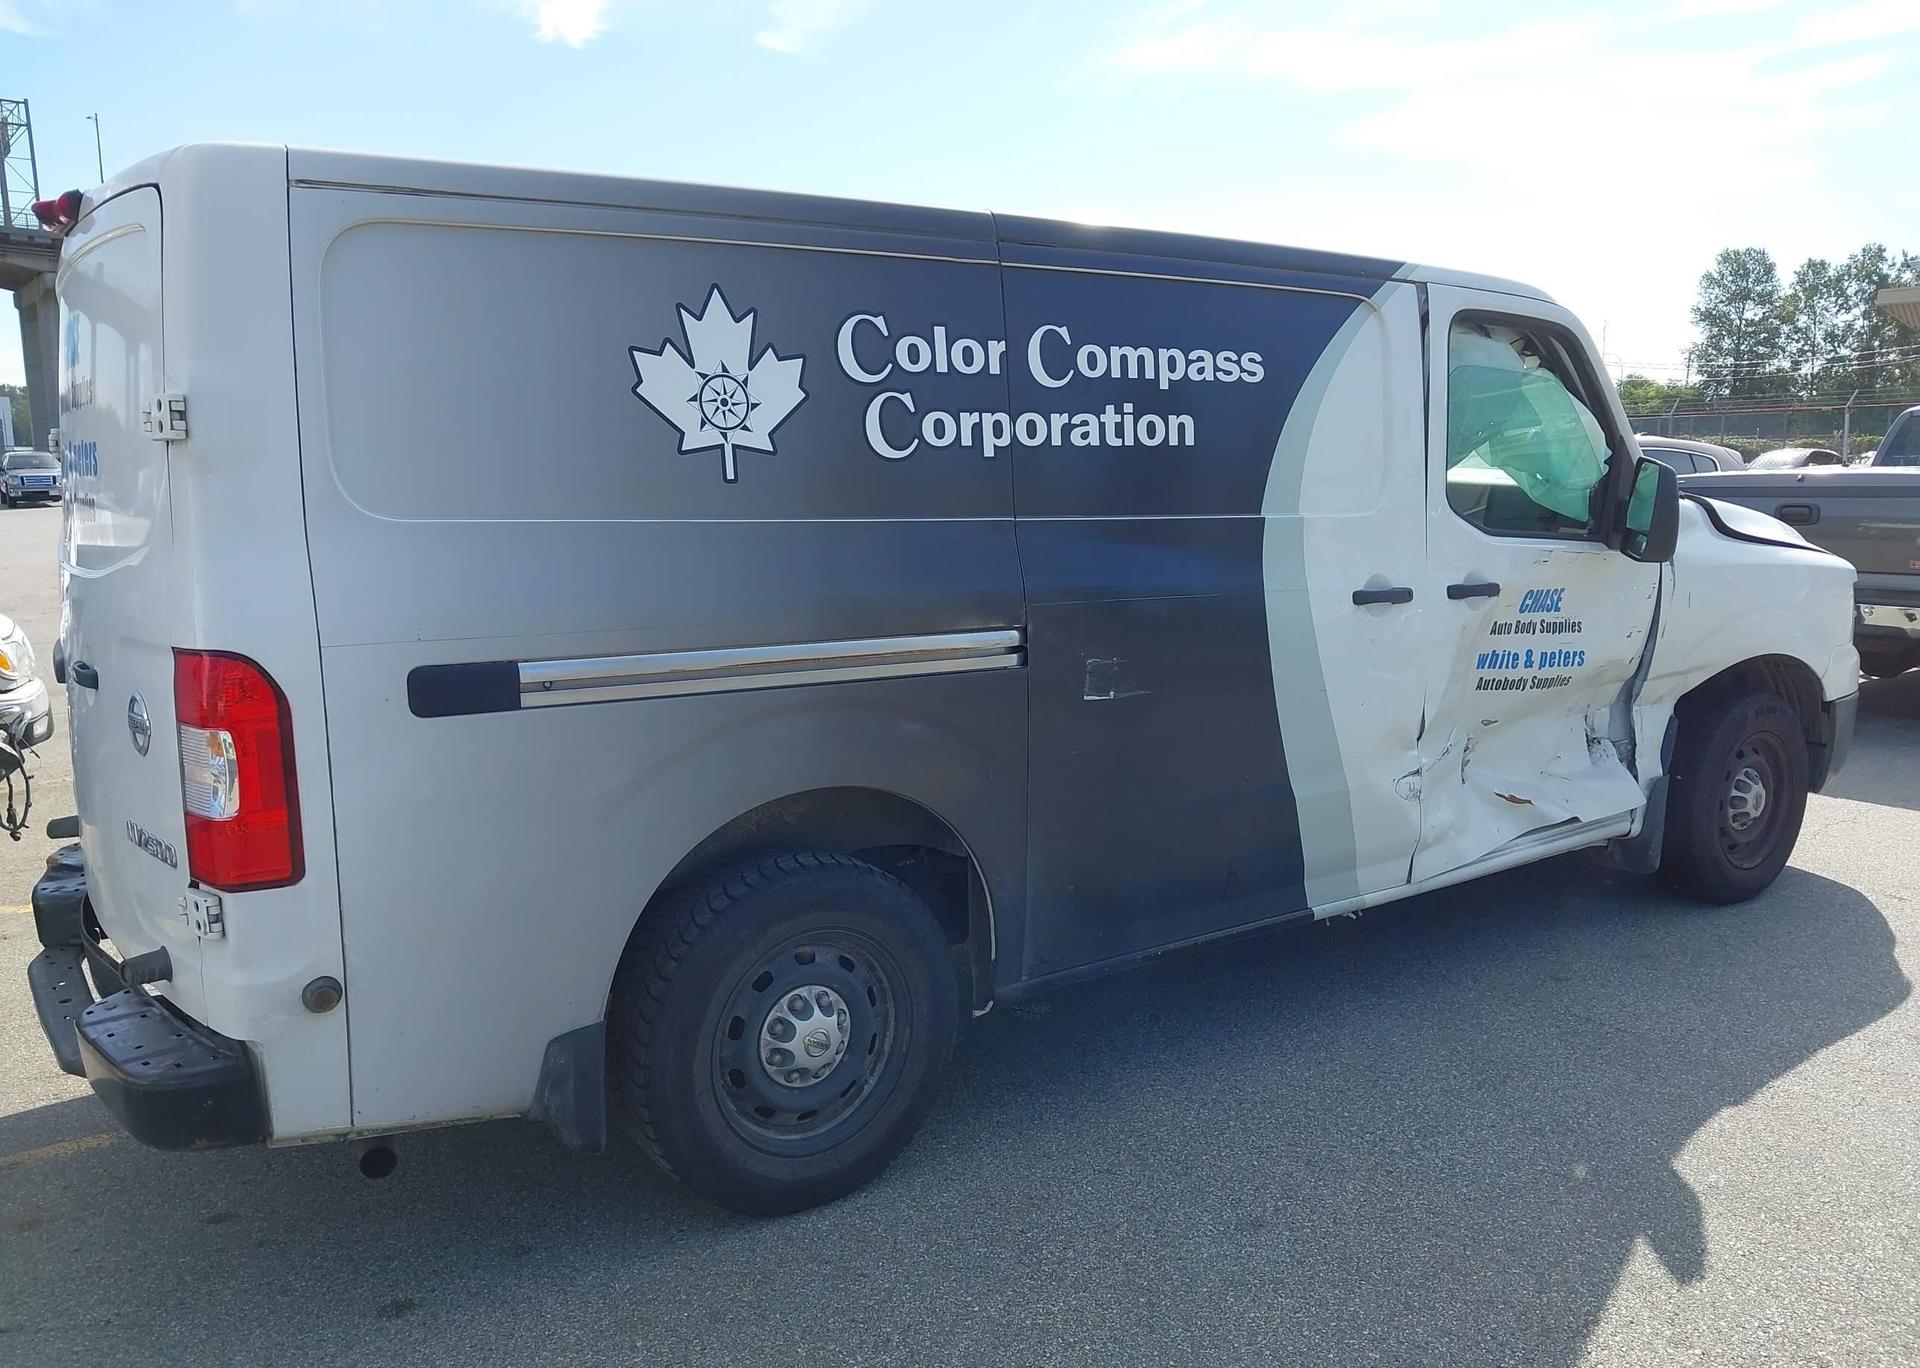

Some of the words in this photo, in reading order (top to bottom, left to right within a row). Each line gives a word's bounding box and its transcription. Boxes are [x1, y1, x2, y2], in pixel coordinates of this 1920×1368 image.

[837, 314, 1006, 384] Color
[1027, 324, 1265, 390] Compass
[864, 391, 1195, 459] Corporation
[1518, 588, 1565, 614] CHASE
[1489, 621, 1512, 636] Auto
[1514, 619, 1538, 636] Body
[1539, 618, 1583, 635] Supplies
[1475, 650, 1520, 670] white
[1524, 649, 1535, 669] &
[1537, 649, 1586, 671] peters
[1474, 676, 1529, 692] Autobody
[1529, 674, 1573, 691] Supplies
